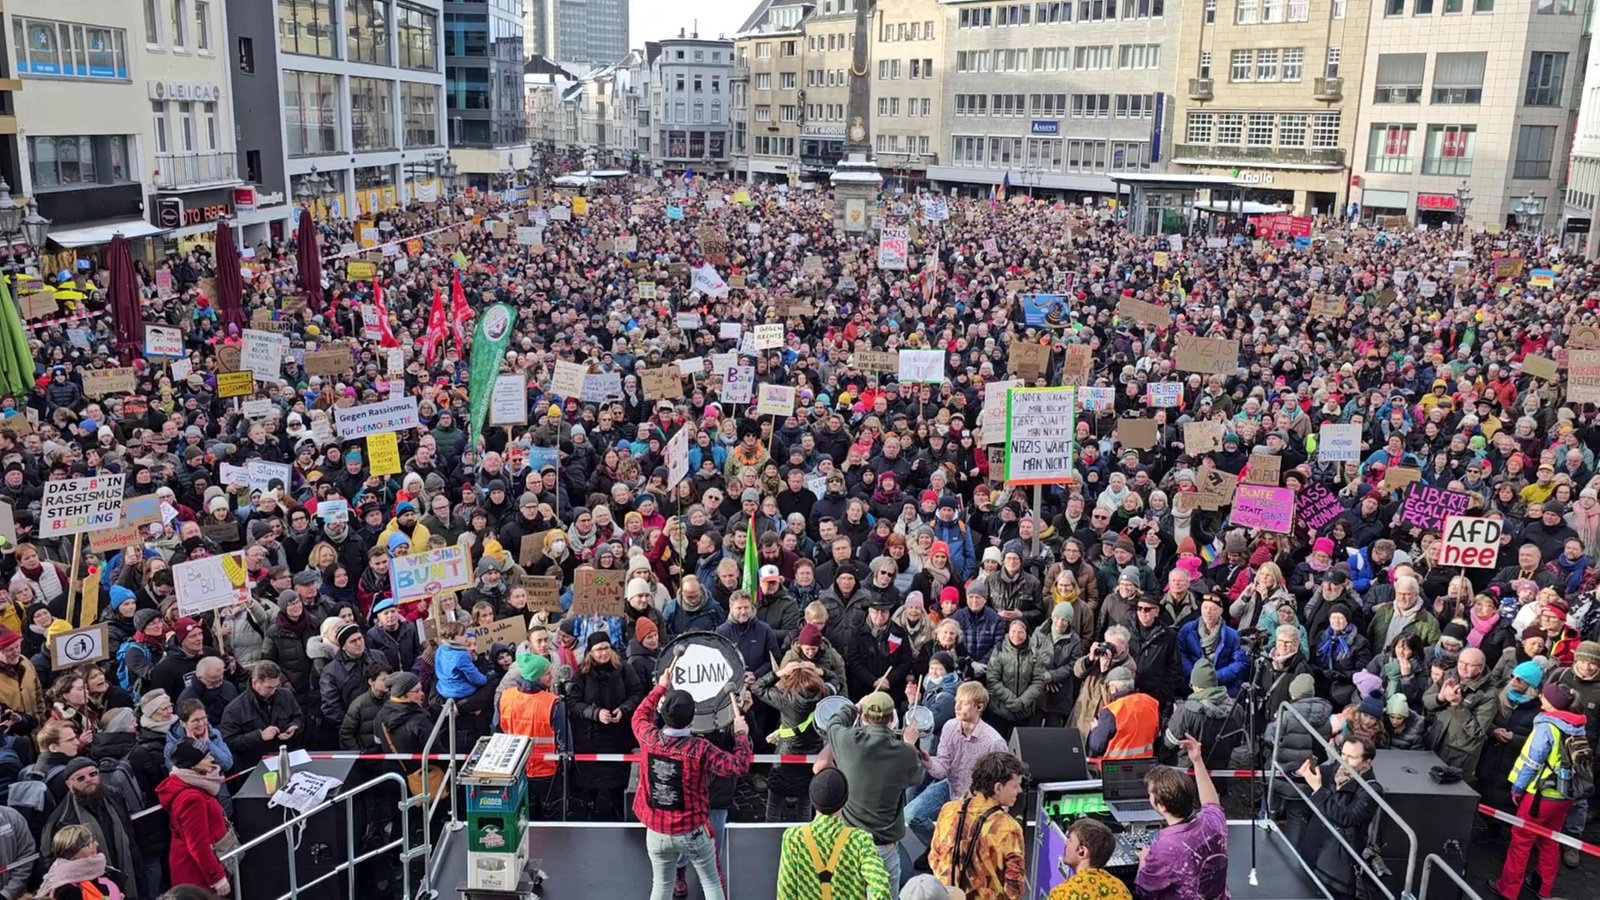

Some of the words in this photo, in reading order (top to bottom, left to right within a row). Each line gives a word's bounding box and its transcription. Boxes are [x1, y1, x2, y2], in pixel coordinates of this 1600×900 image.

[169, 83, 210, 99] LEICA
[1241, 171, 1275, 184] Thalia
[882, 229, 907, 239] NAZIS
[1177, 337, 1236, 356] NAZIS
[1013, 392, 1042, 402] KINDER
[339, 410, 367, 423] Gegen
[368, 402, 413, 417] Rassismus,
[1028, 405, 1042, 413] MAN
[1046, 405, 1068, 413] NICHT
[1012, 416, 1034, 426] TIERE
[342, 426, 354, 437] für
[1027, 428, 1041, 436] MAN
[1043, 428, 1066, 437] NICHT
[1011, 440, 1041, 454] NAZIS
[1023, 457, 1043, 471] MAN
[1045, 457, 1070, 470] NICHT
[48, 481, 78, 494] DAS
[107, 476, 122, 487] IN
[1240, 487, 1275, 500] BUNTE
[45, 488, 122, 507] RASSISMUS
[1295, 482, 1327, 511] HASS
[47, 504, 91, 518] STEHT
[97, 499, 121, 511] FÜR
[1238, 504, 1263, 515] STATT
[1300, 505, 1316, 519] IST
[1314, 492, 1338, 510] KEINE
[52, 512, 113, 530] BILDUNG
[1306, 502, 1345, 530] MEINUNG
[1401, 510, 1431, 529] FCK
[1446, 519, 1502, 545] AfD
[405, 551, 431, 567] WIR
[433, 547, 461, 562] SIND
[1444, 544, 1496, 567] nee
[397, 558, 463, 589] BUNT
[596, 586, 619, 597] NN
[578, 603, 619, 613] BUNT
[474, 627, 489, 637] AFD
[675, 662, 731, 685] BUMM
